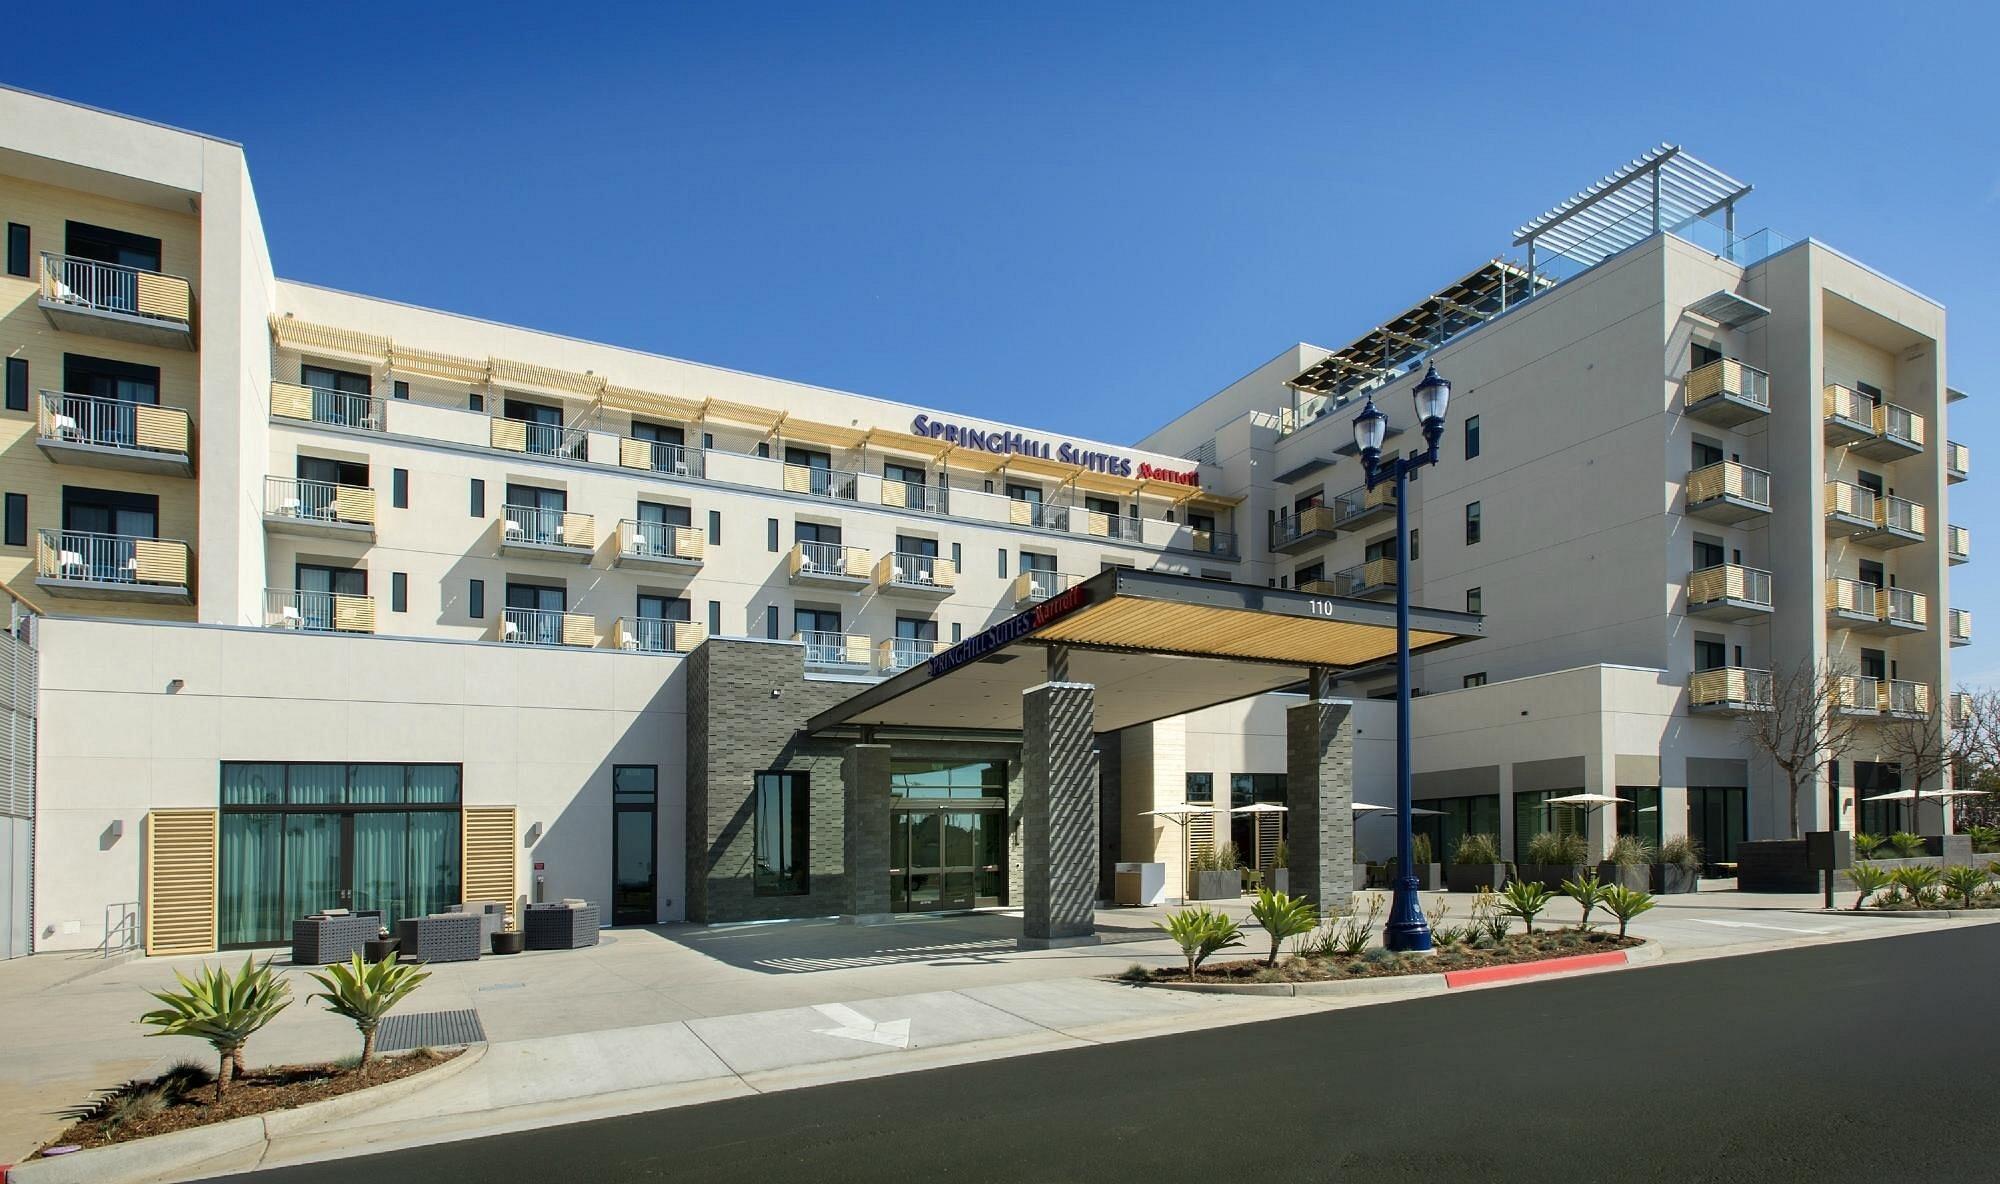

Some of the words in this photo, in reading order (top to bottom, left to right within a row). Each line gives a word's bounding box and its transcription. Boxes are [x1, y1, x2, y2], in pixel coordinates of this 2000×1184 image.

[1135, 461, 1199, 487] Marriott
[1033, 586, 1082, 628] Marriott
[1309, 599, 1333, 616] 110
